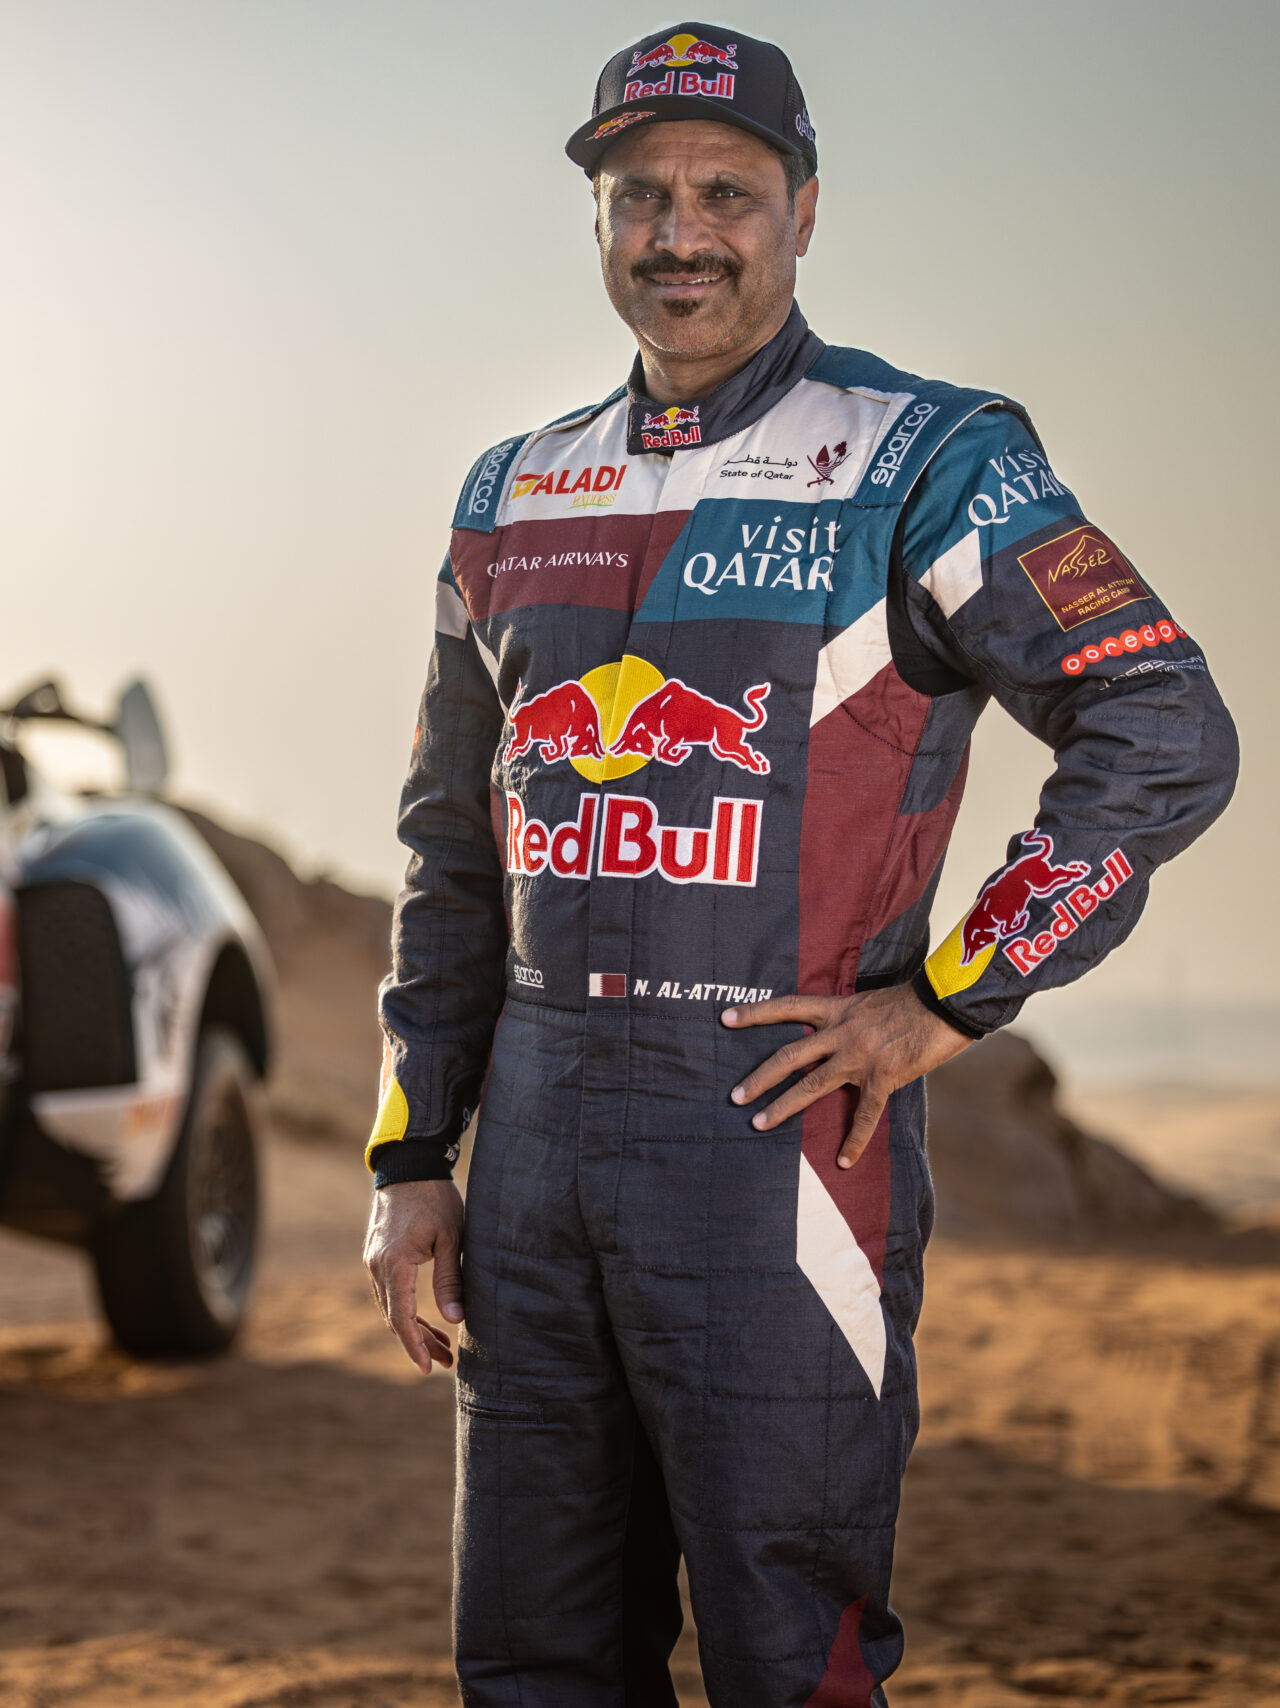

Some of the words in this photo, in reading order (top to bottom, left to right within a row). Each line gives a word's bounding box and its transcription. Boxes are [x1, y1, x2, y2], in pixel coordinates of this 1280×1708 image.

[623, 71, 675, 102] Red
[678, 72, 735, 100] Bull
[641, 430, 671, 449] Red
[671, 425, 701, 446] Bull
[871, 403, 936, 486] sparco
[720, 470, 748, 478] State
[751, 470, 762, 478] of
[764, 470, 794, 480] Qatar
[989, 446, 1047, 478] visi
[472, 443, 513, 514] sparco
[741, 515, 841, 554] visit
[487, 556, 542, 578] QATAR
[545, 551, 629, 568] AIRWAYS
[683, 552, 835, 595] QATAR
[1048, 535, 1113, 592] NASSER
[1061, 591, 1096, 613] NASSER
[1096, 586, 1108, 596] AL
[1077, 595, 1111, 616] RACING
[506, 791, 600, 880] Red
[597, 793, 764, 887] Bull
[1002, 901, 1079, 977] Red
[1064, 848, 1134, 922] Bull
[633, 979, 651, 997] N.
[656, 981, 773, 1003] AL-ATTIYAH
